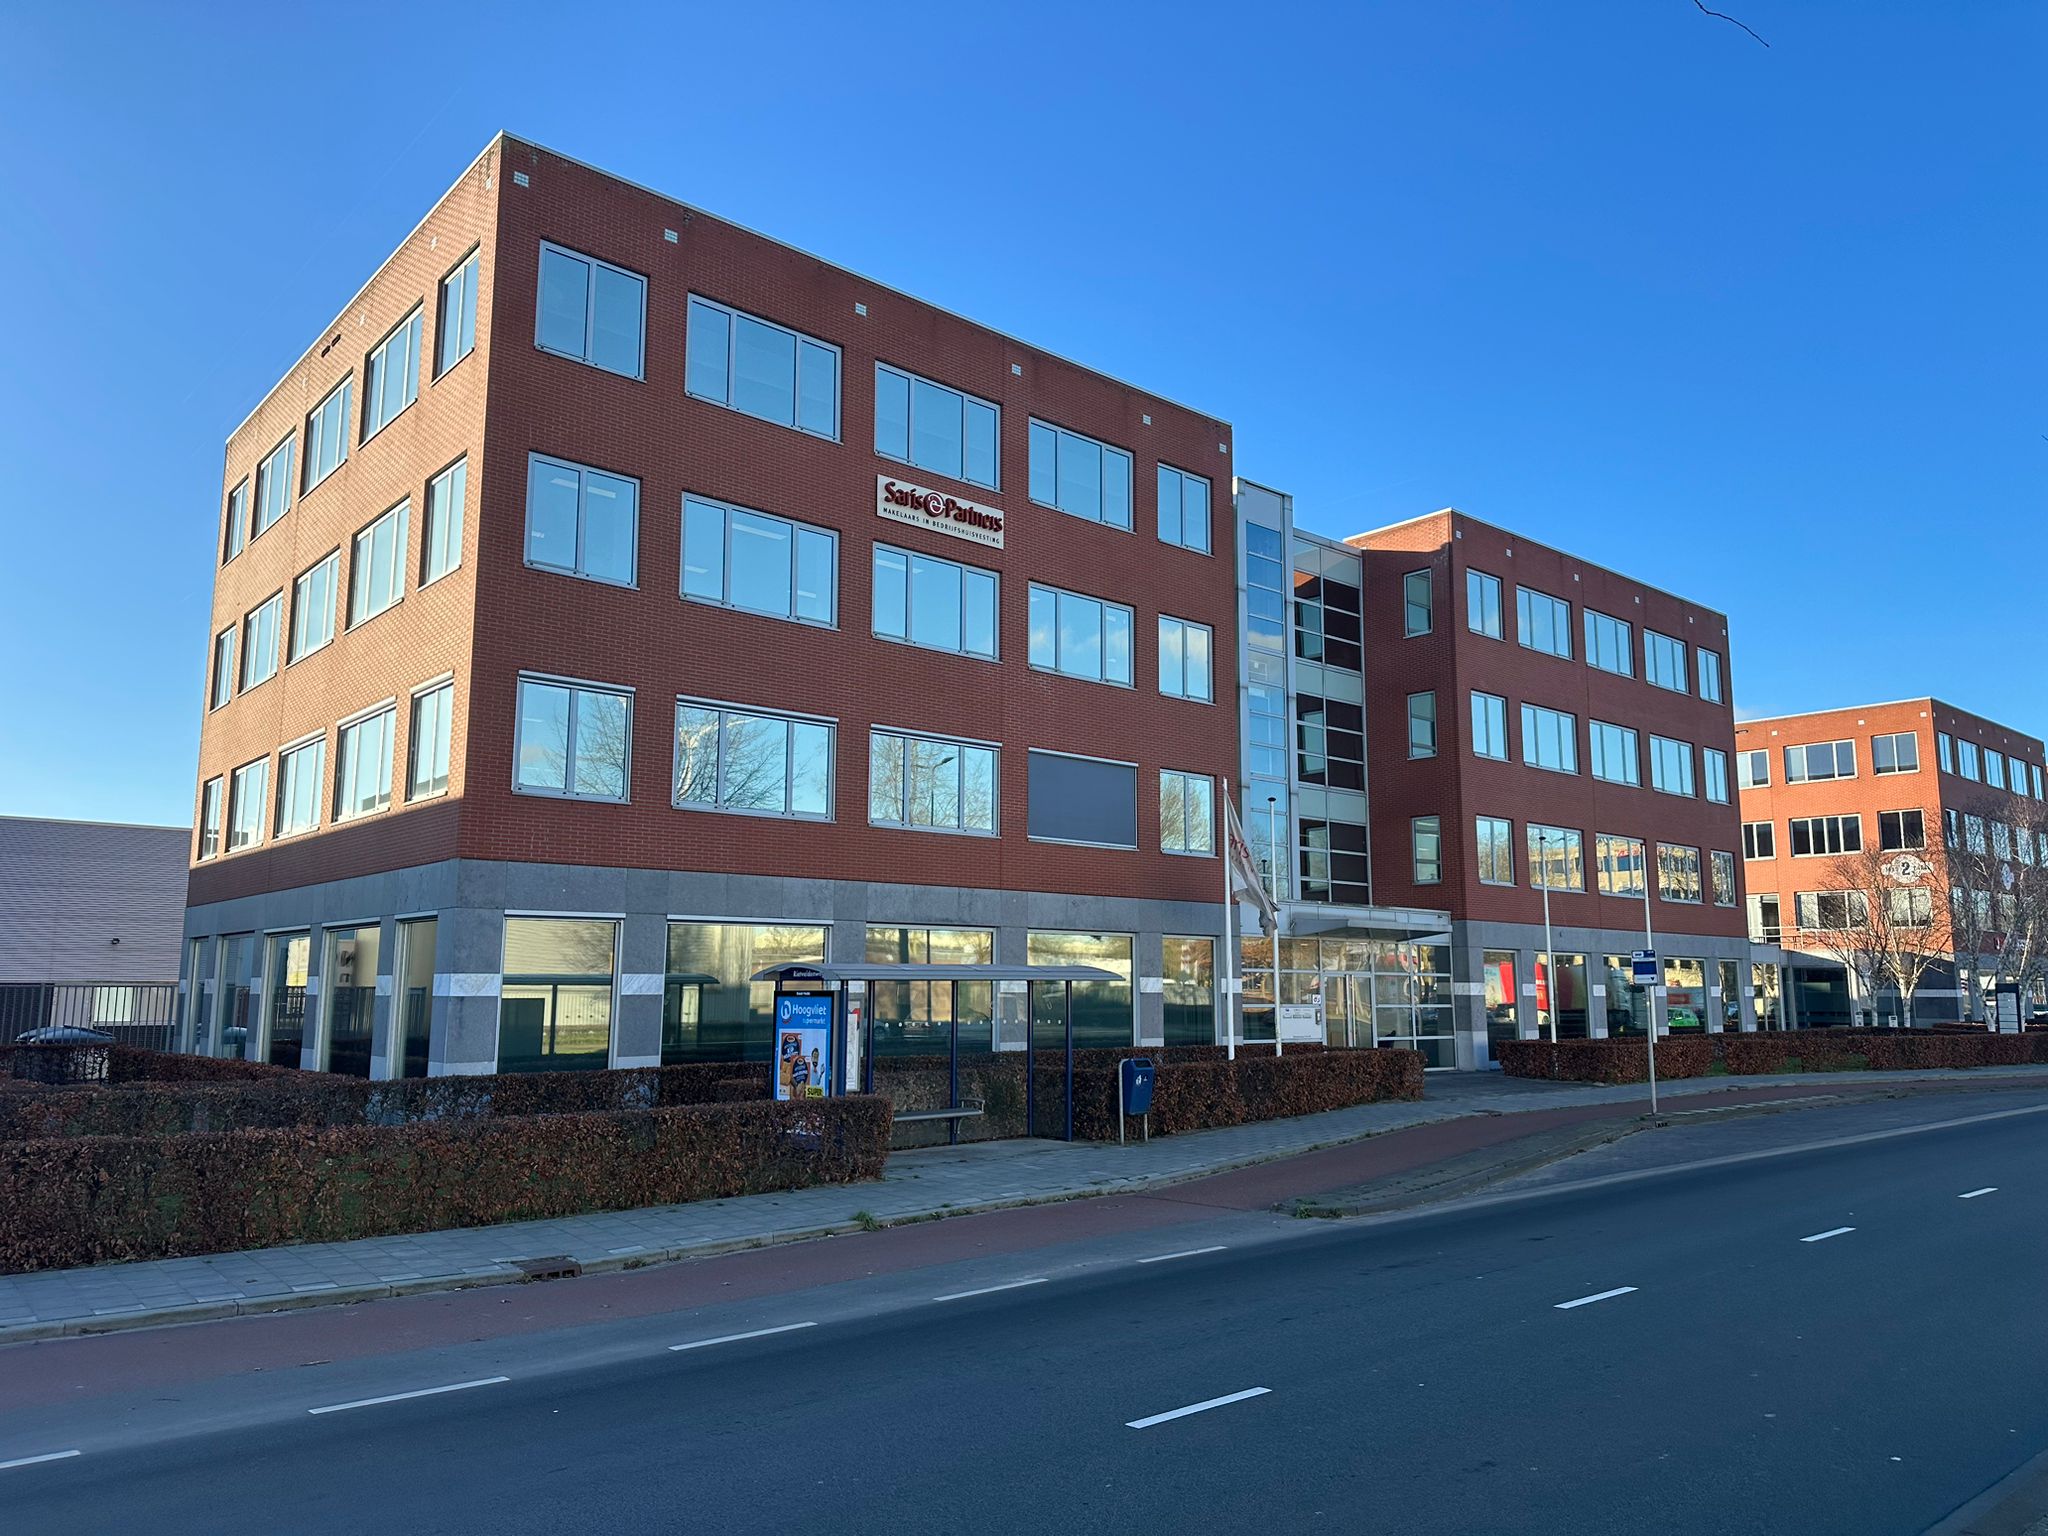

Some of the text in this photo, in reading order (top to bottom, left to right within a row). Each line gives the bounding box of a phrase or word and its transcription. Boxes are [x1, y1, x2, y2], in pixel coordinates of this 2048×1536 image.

[884, 481, 923, 510] Saris
[945, 498, 1003, 532] Partners
[883, 507, 1001, 544] MAKELAARS IN BEDRIJFSHUISVESTING
[1229, 833, 1250, 859] aris
[1901, 861, 1911, 876] 2
[792, 1003, 827, 1017] Hoogvliet
[807, 1087, 823, 1097] SUPER
